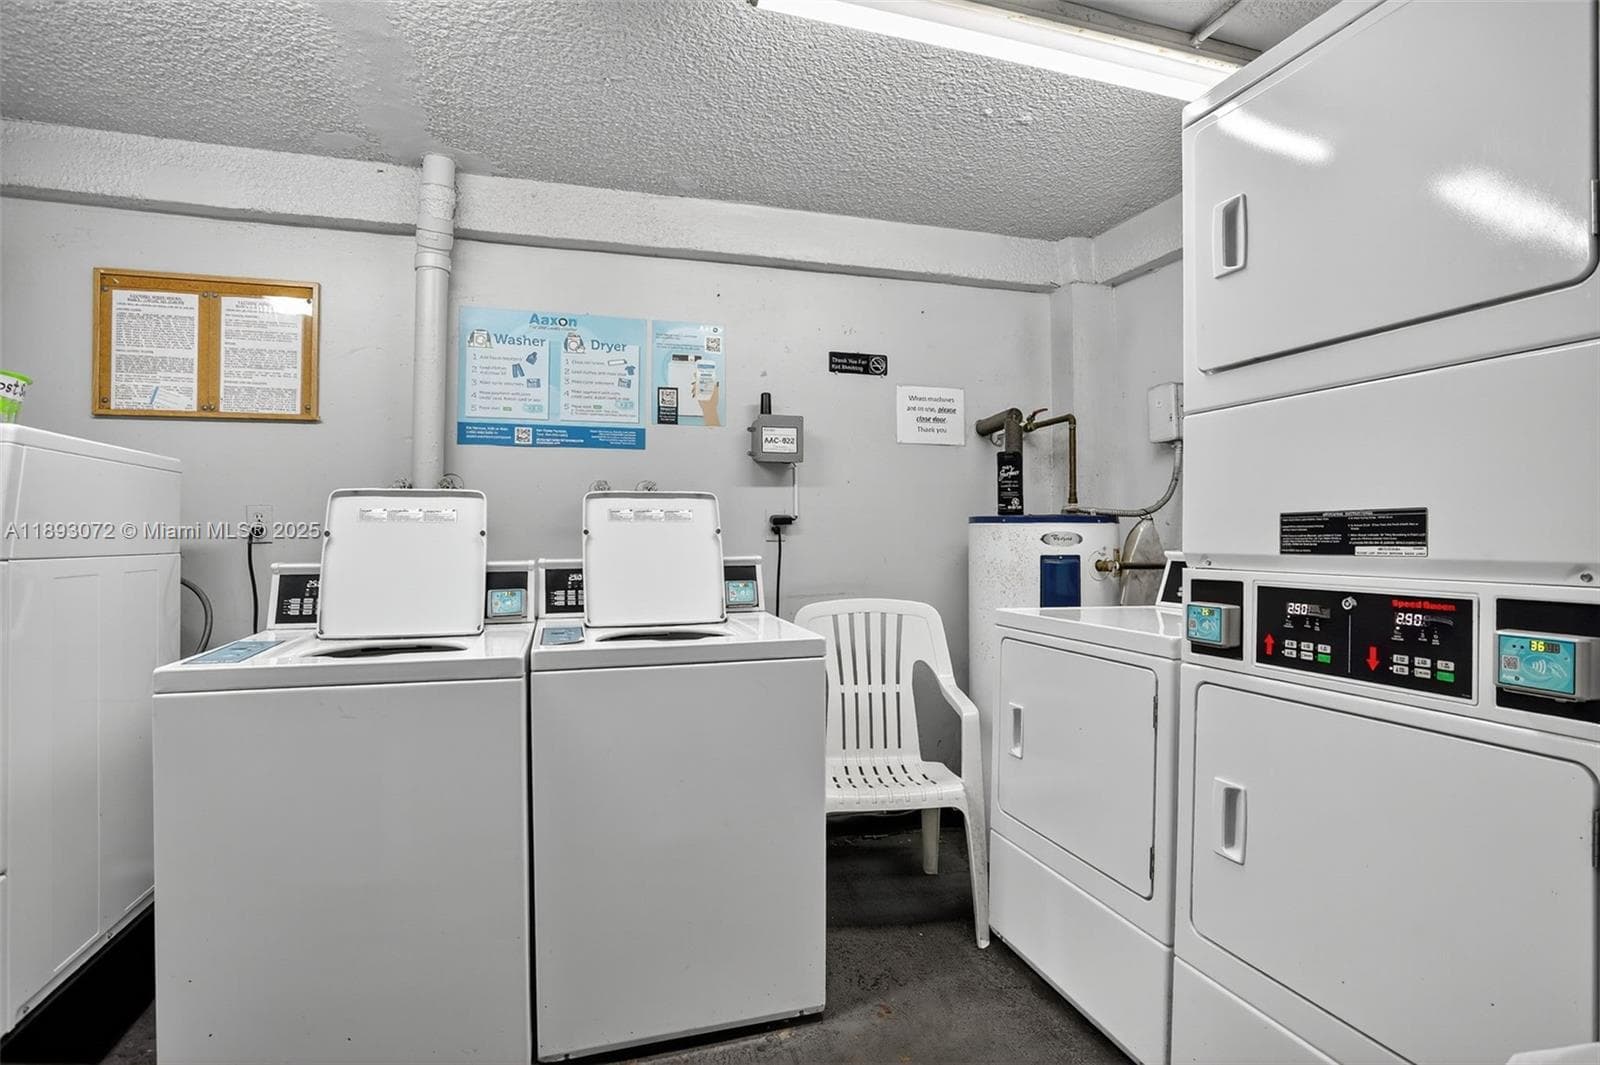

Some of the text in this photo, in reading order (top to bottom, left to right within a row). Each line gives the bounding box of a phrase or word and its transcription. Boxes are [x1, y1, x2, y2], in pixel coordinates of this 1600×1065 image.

[529, 313, 578, 328] Aaxon
[494, 333, 546, 347] Washer
[591, 340, 627, 353] Dryer
[938, 407, 957, 415] please
[1392, 600, 1457, 611] Speed Queen
[1530, 640, 1545, 652] 36
